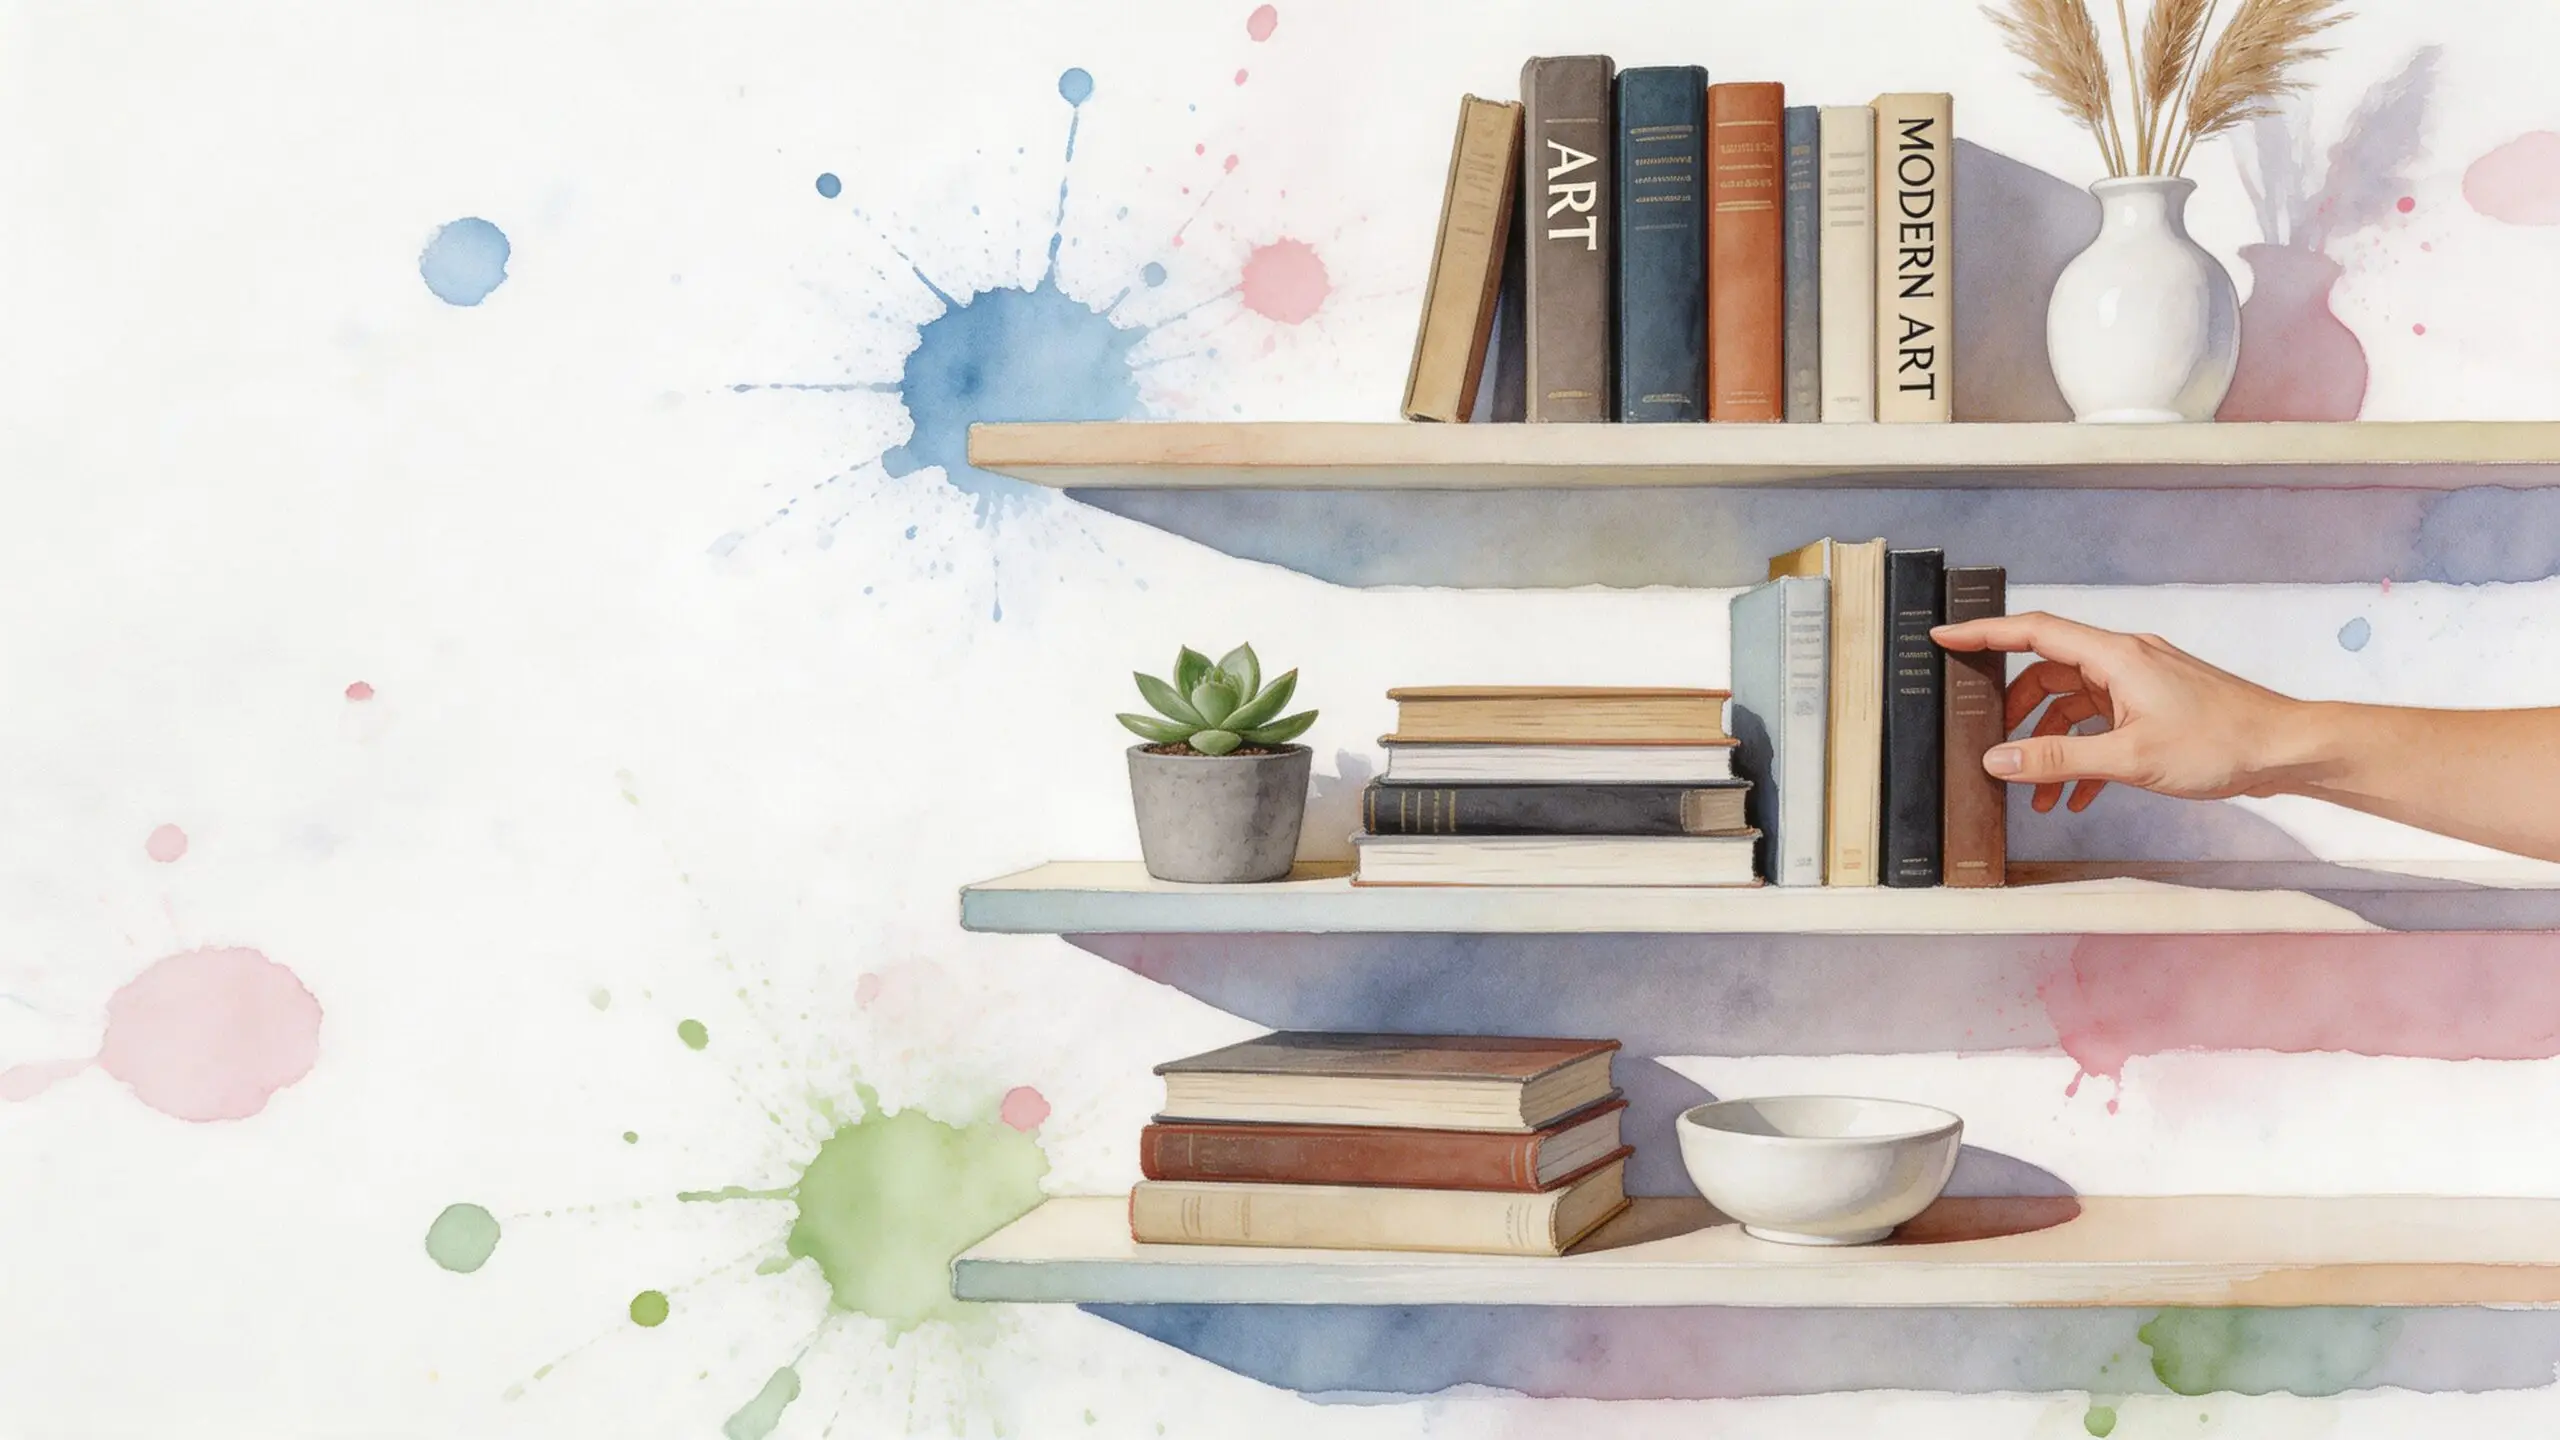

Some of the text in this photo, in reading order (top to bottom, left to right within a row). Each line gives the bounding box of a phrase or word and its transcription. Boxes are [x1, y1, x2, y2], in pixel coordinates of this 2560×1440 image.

[1547, 139, 1598, 251] ART
[1898, 117, 1935, 401] MODERN ART
